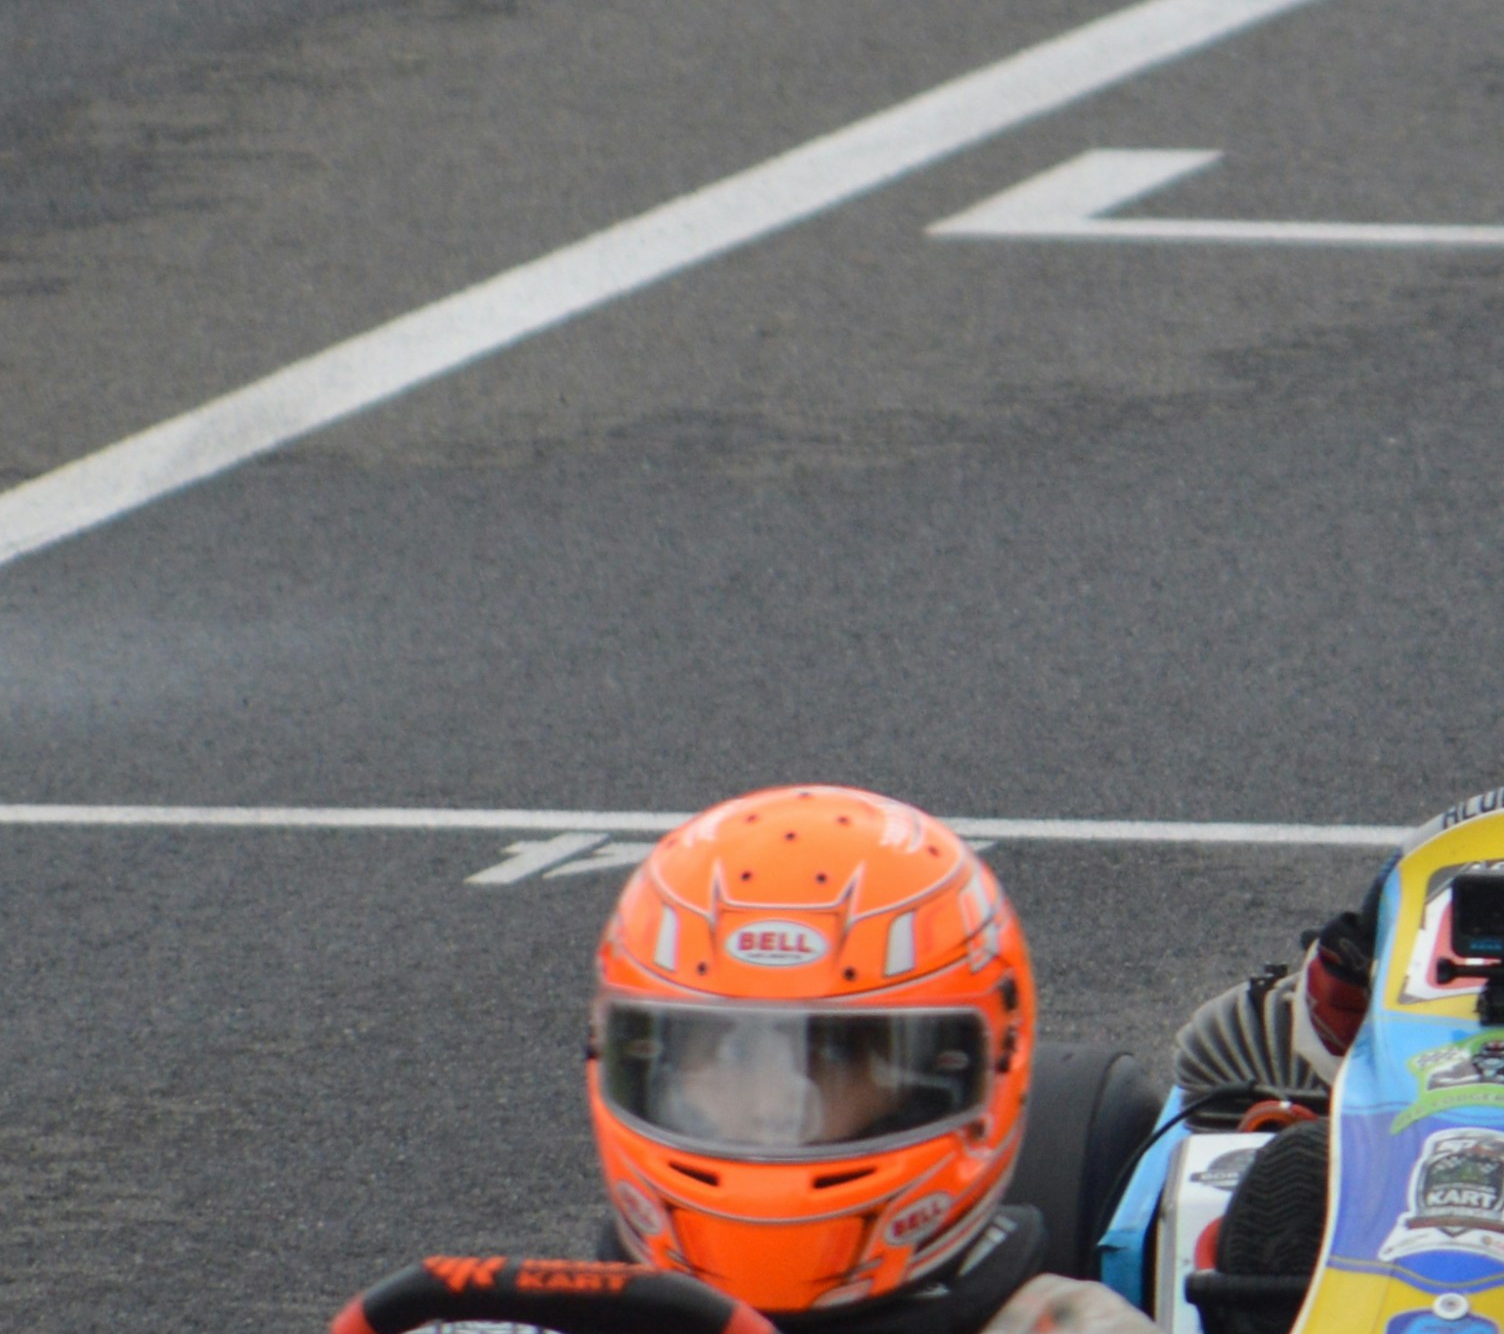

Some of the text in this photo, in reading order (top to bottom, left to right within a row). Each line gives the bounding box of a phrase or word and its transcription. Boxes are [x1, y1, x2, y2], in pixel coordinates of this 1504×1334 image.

[738, 932, 813, 954] BELL
[1425, 1188, 1498, 1210] KART
[889, 1198, 946, 1238] BELL
[516, 1272, 628, 1291] KART
